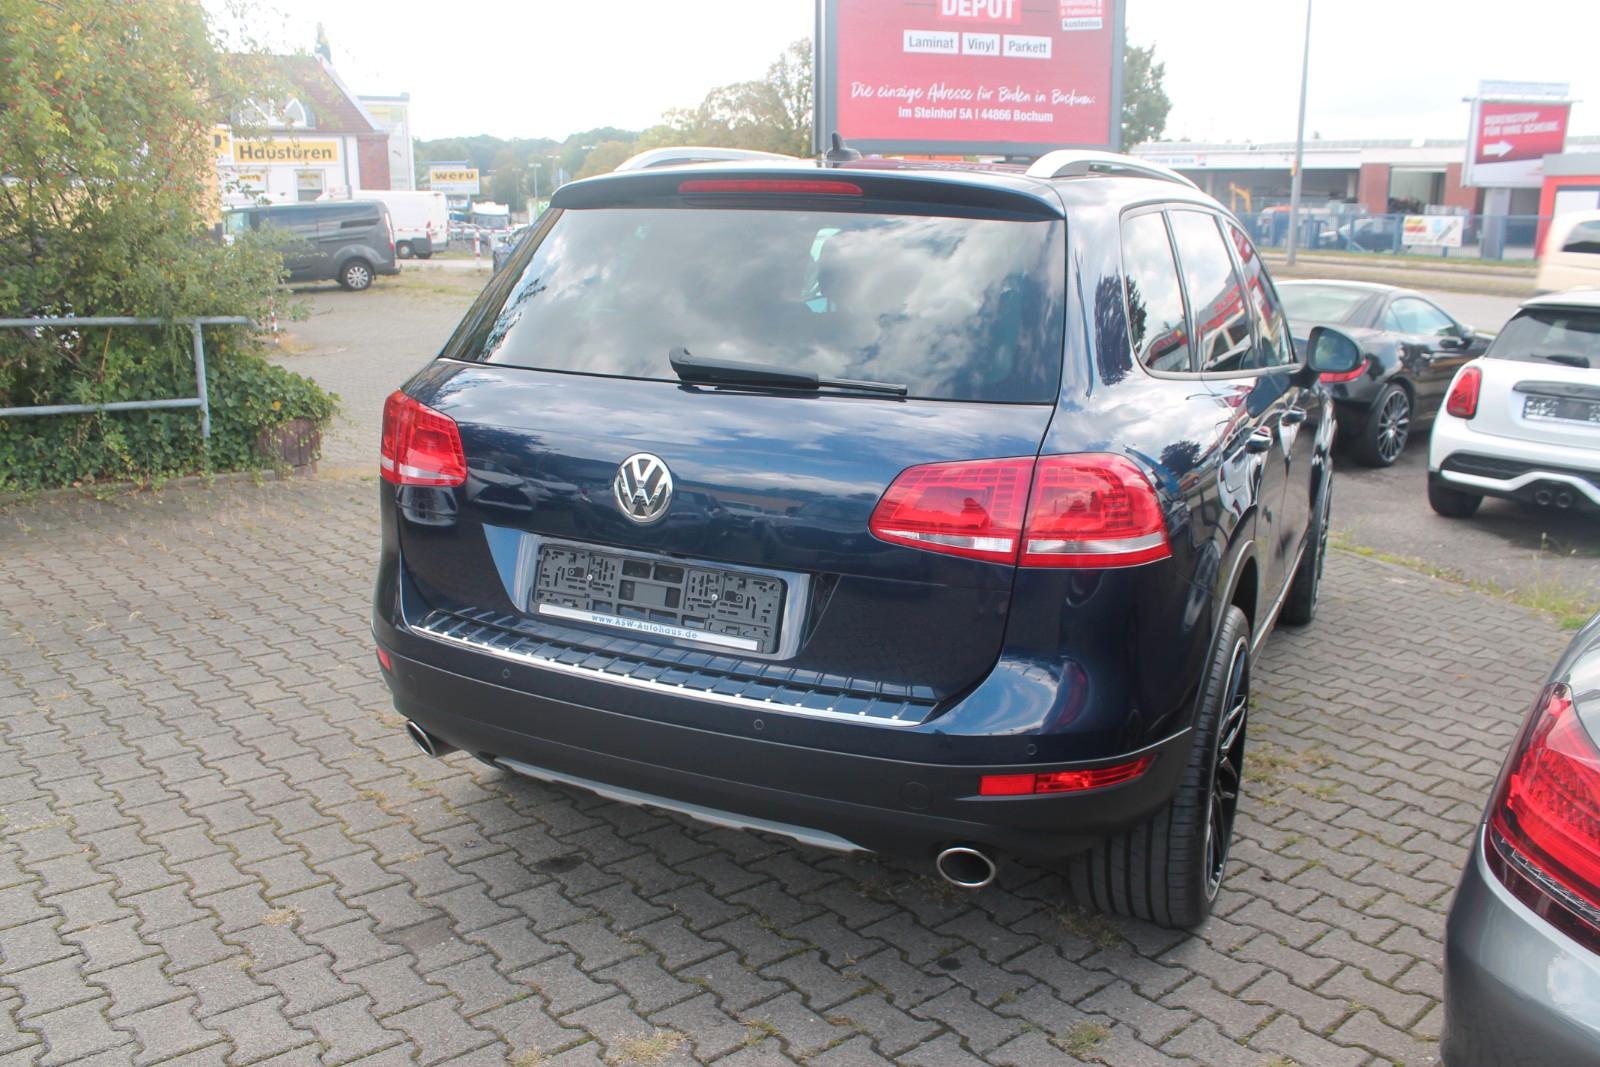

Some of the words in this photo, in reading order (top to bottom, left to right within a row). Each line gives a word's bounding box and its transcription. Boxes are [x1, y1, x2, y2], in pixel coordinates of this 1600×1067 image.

[941, 0, 1016, 19] DEPOT
[909, 35, 954, 49] Laminat
[967, 37, 995, 52] Vinyl
[1008, 40, 1047, 54] Parkett
[850, 81, 874, 98] Die
[877, 84, 924, 104] einzige
[927, 81, 974, 104] Adresse
[976, 85, 994, 102] für
[1034, 89, 1046, 103] in
[898, 106, 912, 118] Im
[914, 106, 957, 119] Steinhof
[959, 108, 972, 120] 5A
[1013, 109, 1054, 123] Bochum
[239, 144, 332, 160] Haustüren
[435, 171, 475, 181] weru
